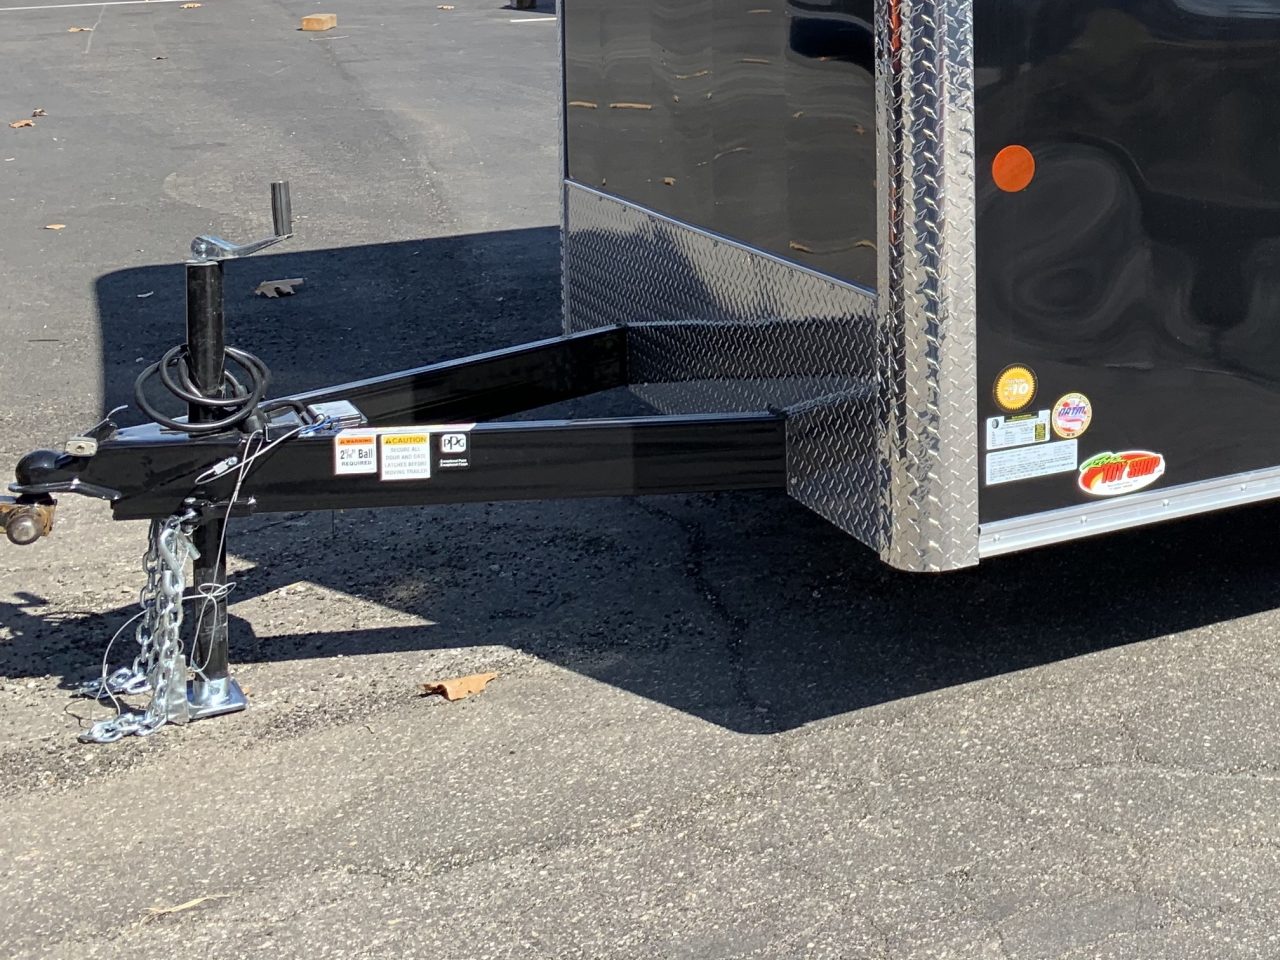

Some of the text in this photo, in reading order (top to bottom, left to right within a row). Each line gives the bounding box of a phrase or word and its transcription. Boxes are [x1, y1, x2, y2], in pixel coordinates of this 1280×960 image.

[391, 436, 427, 445] CAUTION
[443, 436, 465, 450] PPG
[358, 448, 373, 459] Ball
[1101, 461, 1128, 484] TOY
[1127, 456, 1160, 478] SHOP
